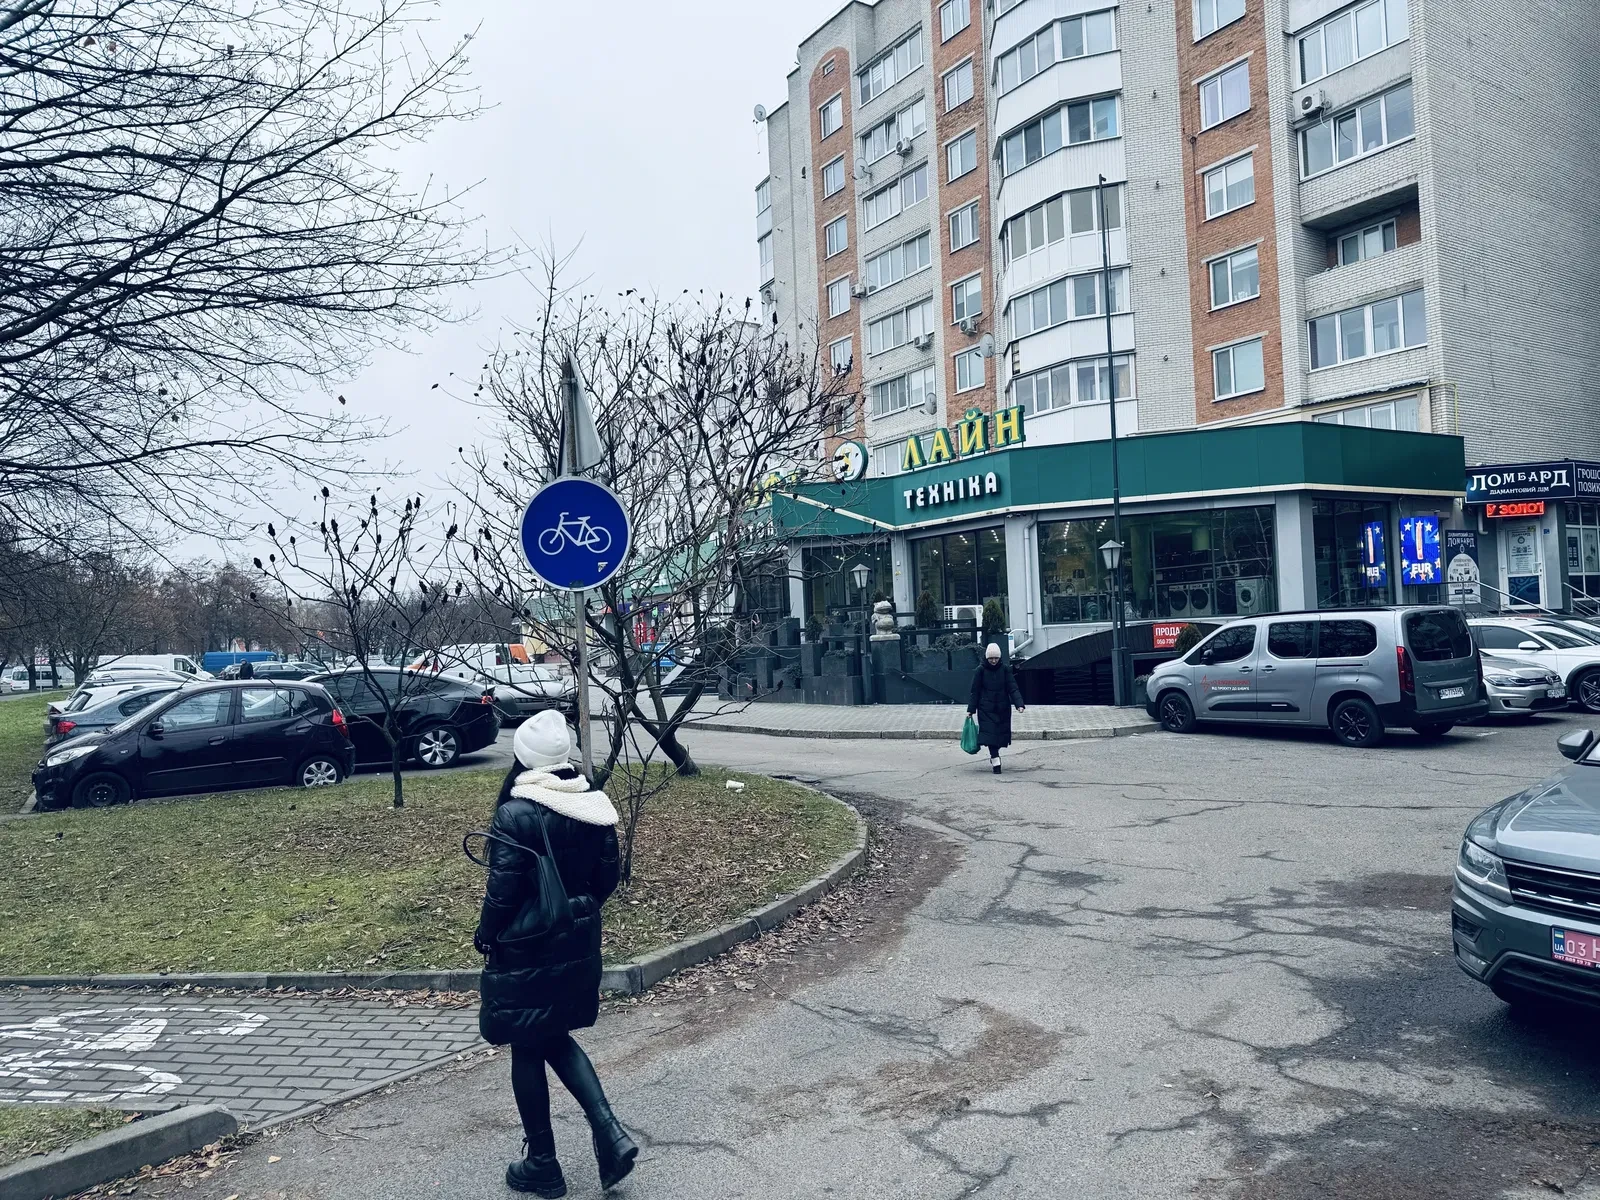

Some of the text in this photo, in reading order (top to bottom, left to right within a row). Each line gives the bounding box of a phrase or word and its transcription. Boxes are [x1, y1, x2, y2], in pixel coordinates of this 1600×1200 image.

[902, 404, 1026, 471] ЛАЙН
[1470, 470, 1570, 491] ЛОМБАРД
[904, 471, 998, 510] ТЕХНІКА
[1411, 562, 1432, 574] EUR
[1155, 626, 1182, 637] ПРОДА
[1554, 944, 1564, 952] UA
[1567, 940, 1586, 957] 03
